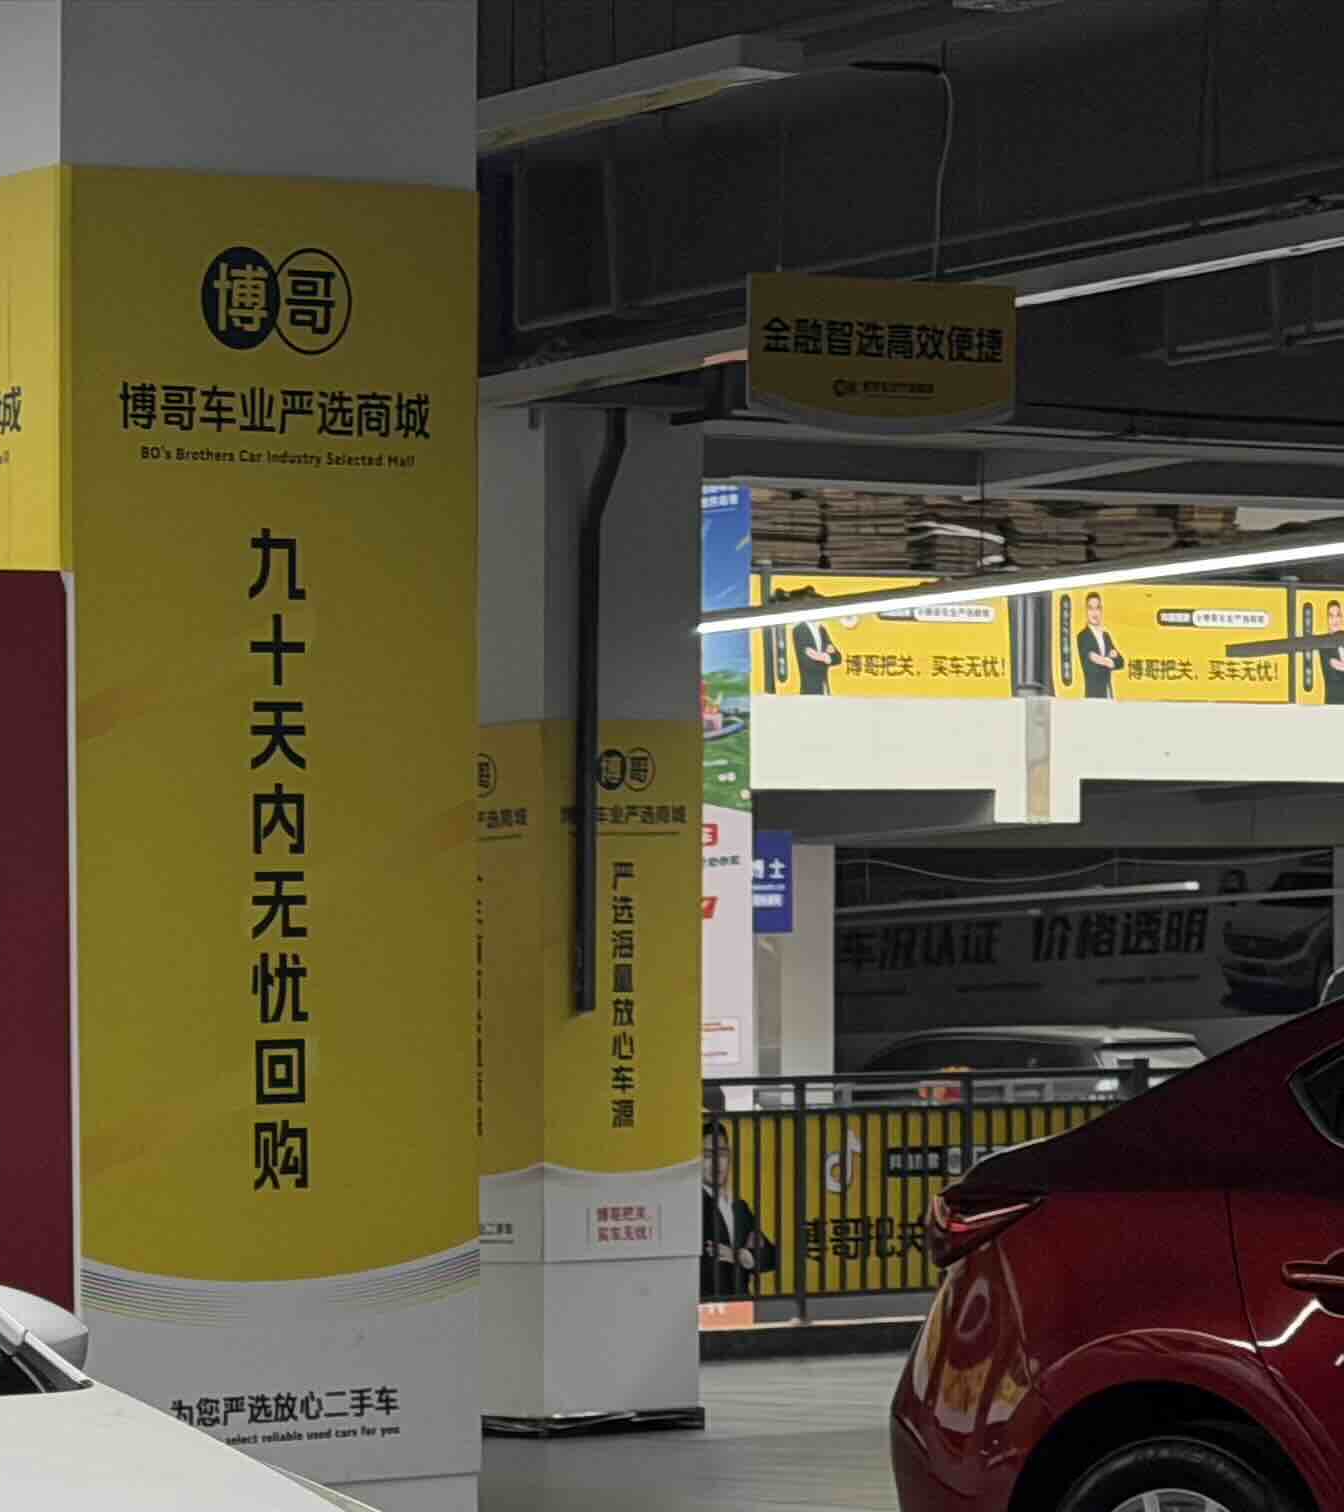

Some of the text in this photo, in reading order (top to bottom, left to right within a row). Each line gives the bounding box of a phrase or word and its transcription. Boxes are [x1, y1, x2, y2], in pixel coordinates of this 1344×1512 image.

[207, 254, 344, 347] 博哥
[763, 317, 1004, 363] 金融智选高效便捷
[119, 382, 431, 439] 博哥车业严选商城
[175, 447, 235, 463] Brothers
[239, 449, 263, 463] Car
[267, 450, 321, 468] Industry
[326, 452, 384, 467] Selected
[387, 454, 416, 468] Mall
[247, 527, 310, 1191] 九十天内无忧回购
[838, 919, 1000, 972] 车况认证
[1031, 907, 1209, 962] 价格透明
[170, 1385, 400, 1429] 为您严选放心二手车
[262, 1431, 303, 1443] reliable
[306, 1429, 332, 1441] used
[335, 1429, 358, 1439] cars
[361, 1425, 377, 1436] for
[380, 1426, 401, 1438] you
